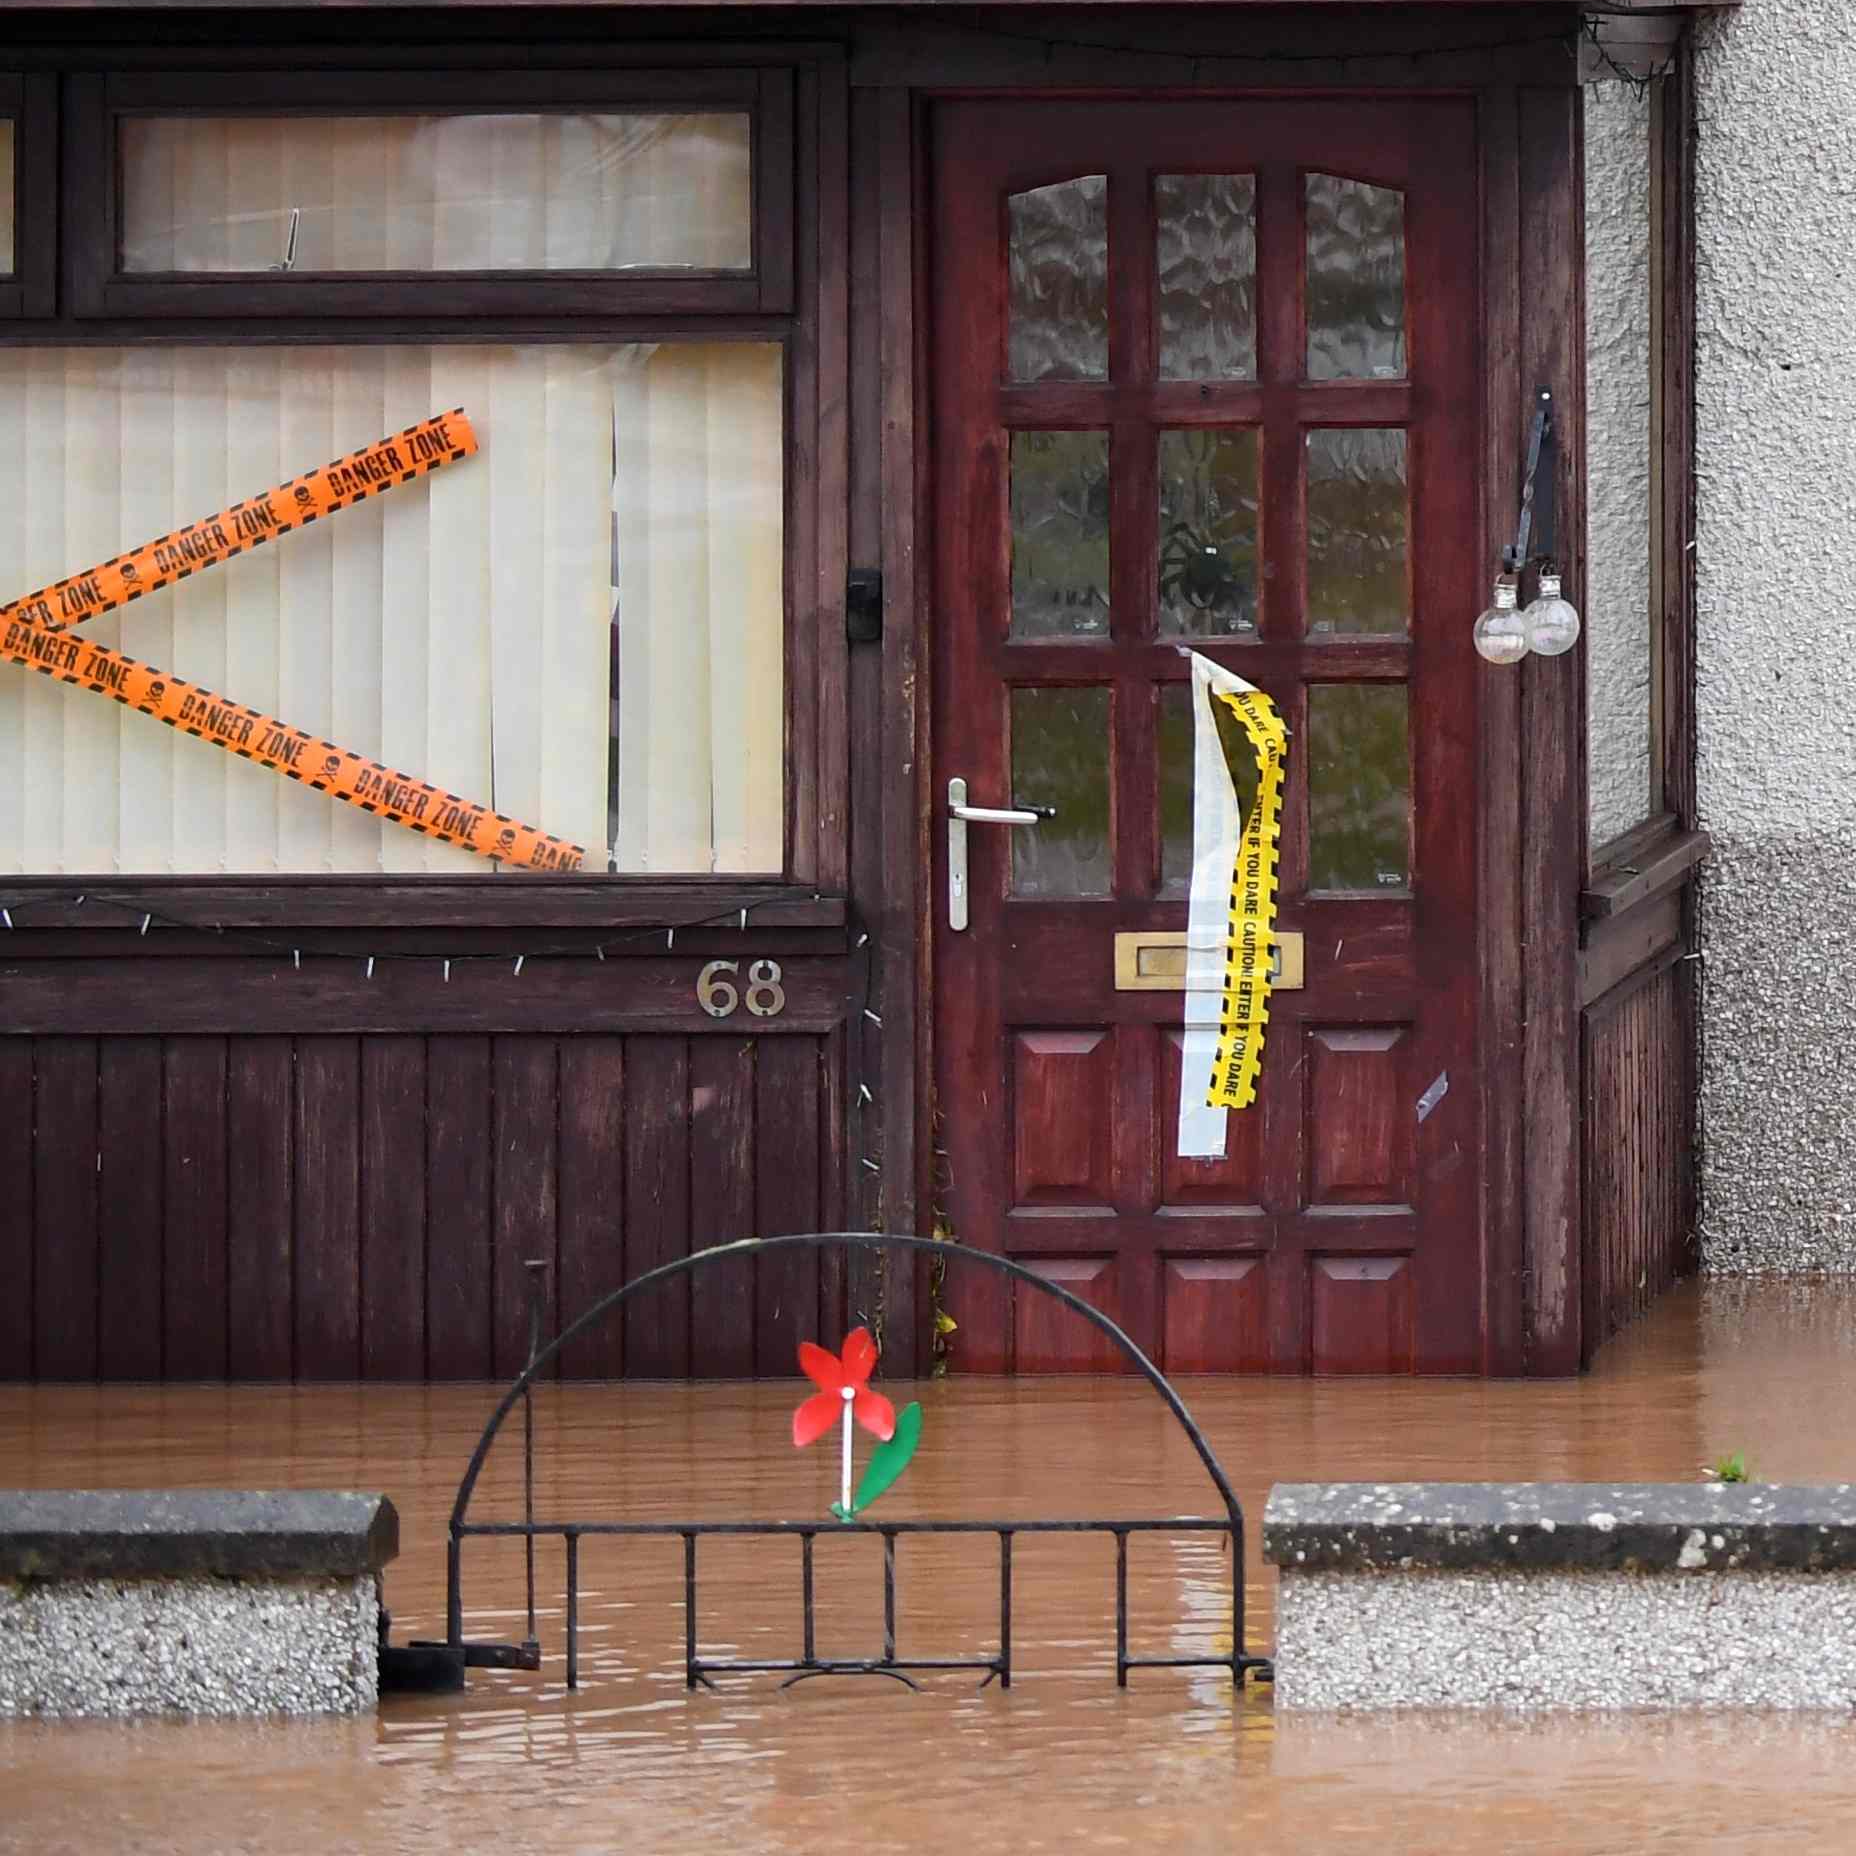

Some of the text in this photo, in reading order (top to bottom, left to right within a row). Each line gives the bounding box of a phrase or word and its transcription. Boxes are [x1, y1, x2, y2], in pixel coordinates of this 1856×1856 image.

[56, 575, 107, 617] ZONE
[153, 524, 229, 575] DANGER
[232, 499, 282, 540] ZONE
[327, 446, 403, 497] DANGER
[405, 423, 456, 464] ZONE
[4, 622, 79, 671] DANGER
[83, 652, 132, 693] ZONE
[178, 694, 254, 746] DANGER
[256, 727, 308, 768] ZONE
[353, 768, 429, 819] DANGER
[431, 800, 483, 841] ZONE
[1244, 706, 1268, 733] DARE
[1246, 852, 1260, 878] YOU
[1244, 881, 1259, 915] DARE
[1241, 921, 1256, 977] CAUTION!
[697, 959, 785, 1017] 68
[1231, 1034, 1247, 1061] YOU
[1223, 1062, 1242, 1097] DARE
